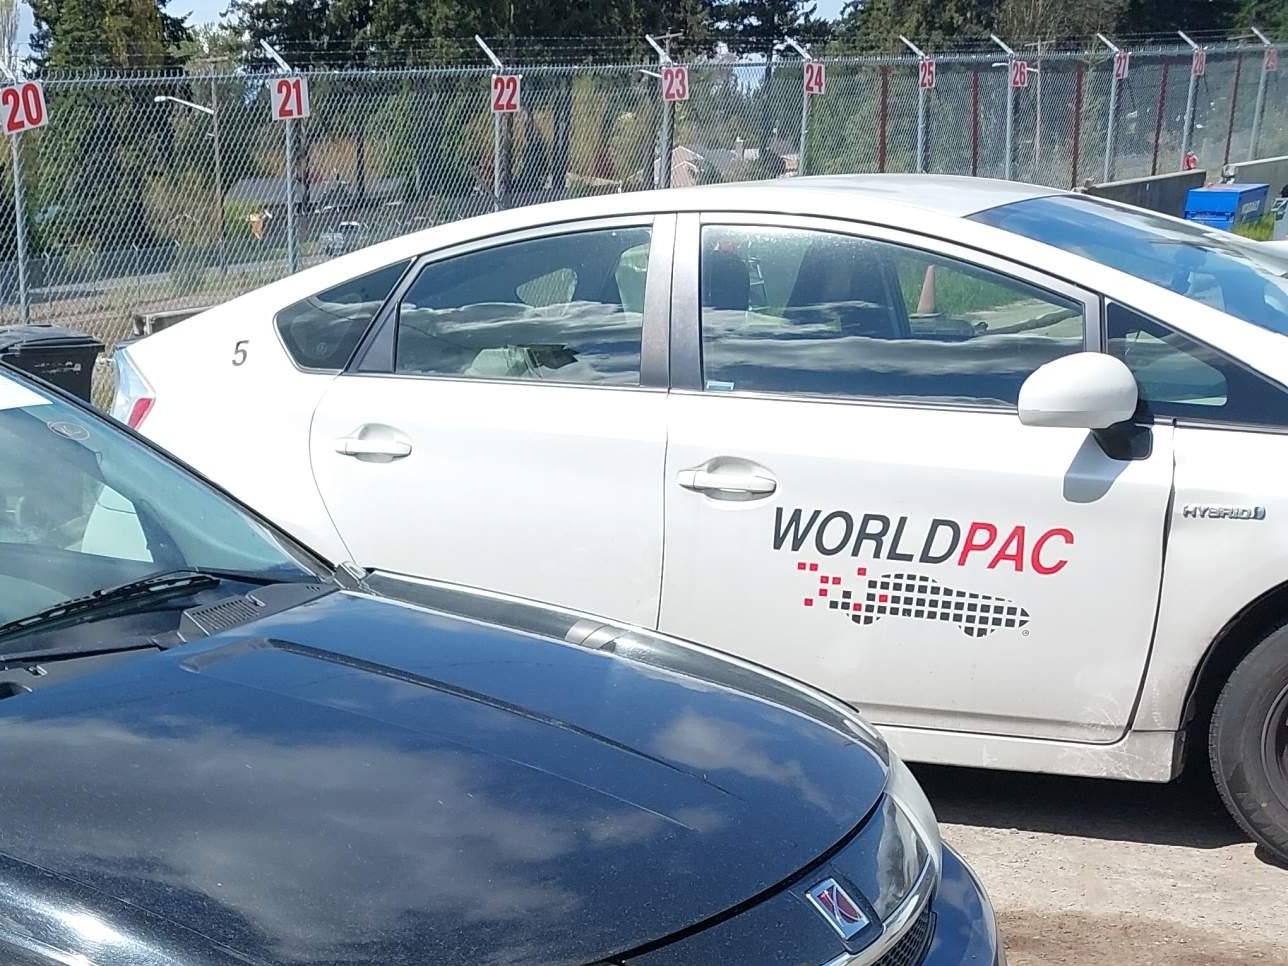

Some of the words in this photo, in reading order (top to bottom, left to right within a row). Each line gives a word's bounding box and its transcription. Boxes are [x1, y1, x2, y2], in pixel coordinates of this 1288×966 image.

[920, 62, 934, 88] 25
[1012, 61, 1027, 86] 26
[1116, 53, 1127, 80] 27
[1193, 52, 1205, 76] 28
[663, 69, 687, 100] 23
[805, 64, 824, 93] 24
[1, 82, 44, 131] 20
[277, 79, 303, 118] 21
[493, 76, 517, 111] 22
[231, 339, 250, 367] 5
[1183, 504, 1253, 520] HYBRID
[772, 506, 1075, 576] WORLDPAC
